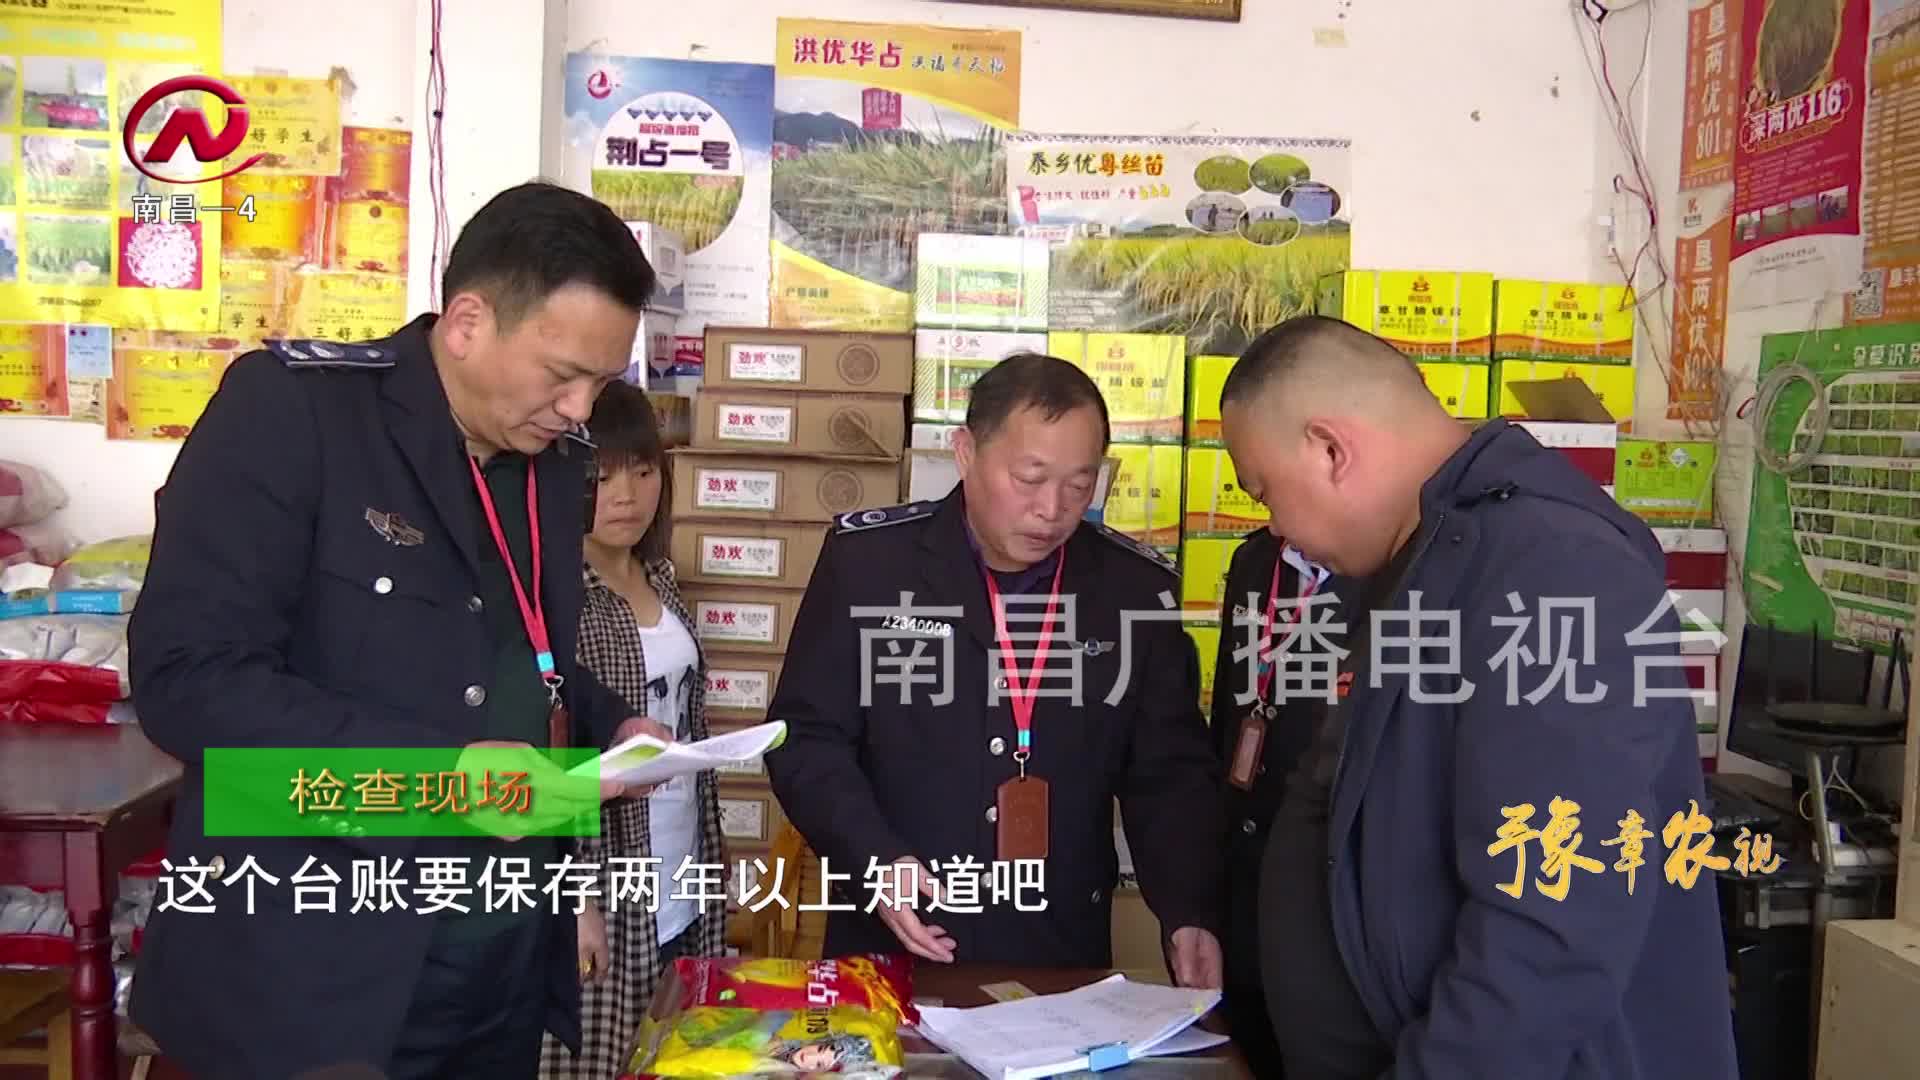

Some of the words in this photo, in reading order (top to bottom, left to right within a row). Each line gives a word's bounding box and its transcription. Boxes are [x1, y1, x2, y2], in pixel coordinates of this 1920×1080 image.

[793, 37, 904, 69] 洪优华占
[1749, 82, 1843, 144] 深两优116
[250, 127, 315, 143] 好学生
[605, 136, 731, 170] 荆占一号
[232, 311, 269, 328] 学生
[738, 351, 767, 366] 劲欢
[727, 412, 756, 427] 劲欢
[707, 477, 738, 493] 劲欢
[712, 544, 743, 561] 劲欢
[705, 608, 737, 626] 劲欢
